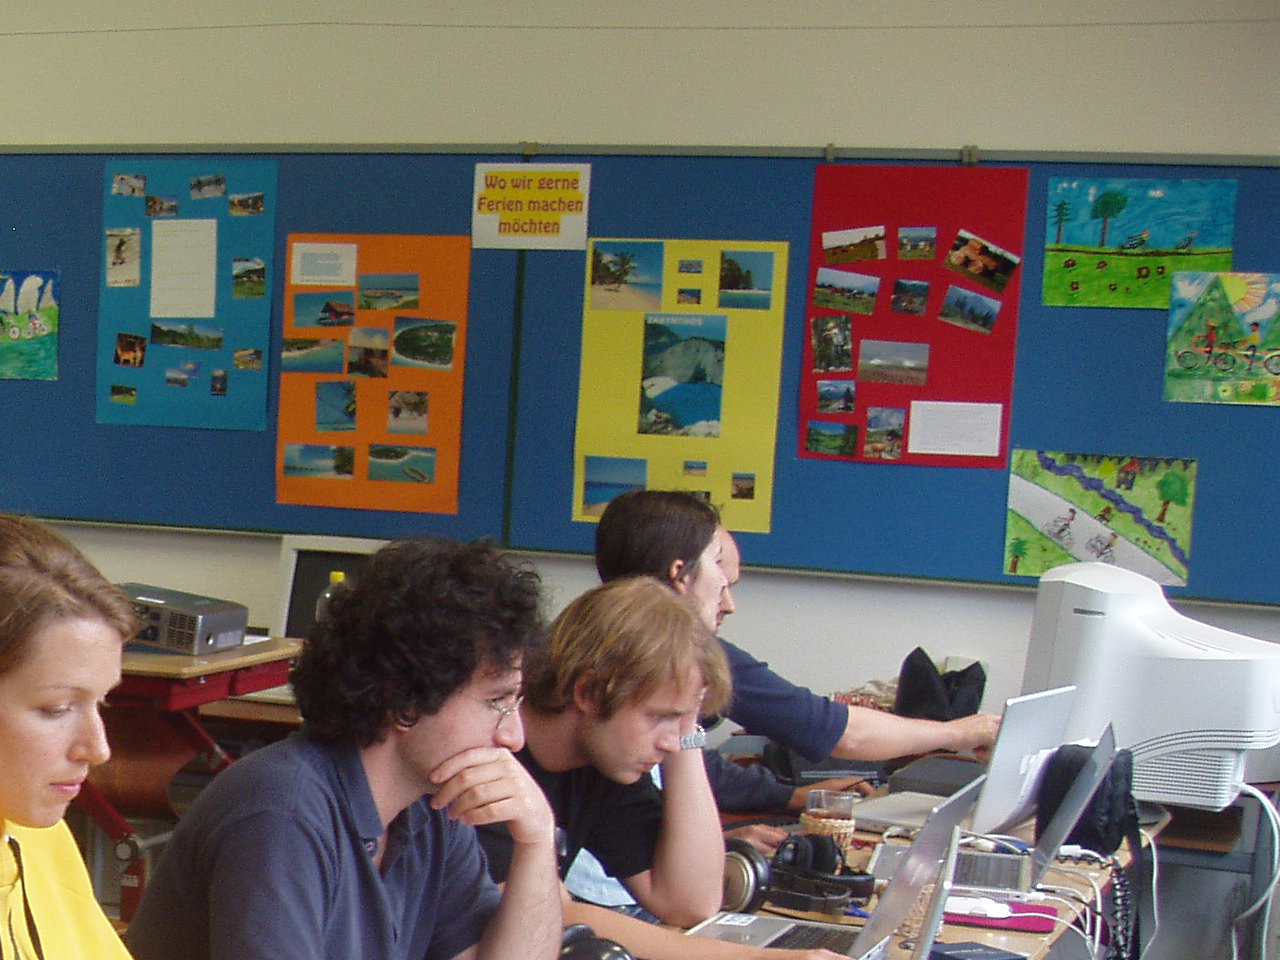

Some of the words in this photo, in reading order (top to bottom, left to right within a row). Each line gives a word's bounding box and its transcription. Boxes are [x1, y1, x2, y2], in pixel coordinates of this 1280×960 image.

[484, 175, 507, 190] Wo
[511, 175, 534, 190] wir
[537, 177, 580, 191] gerne
[477, 196, 523, 212] Ferien
[527, 197, 584, 212] machen
[498, 218, 560, 234] möchten
